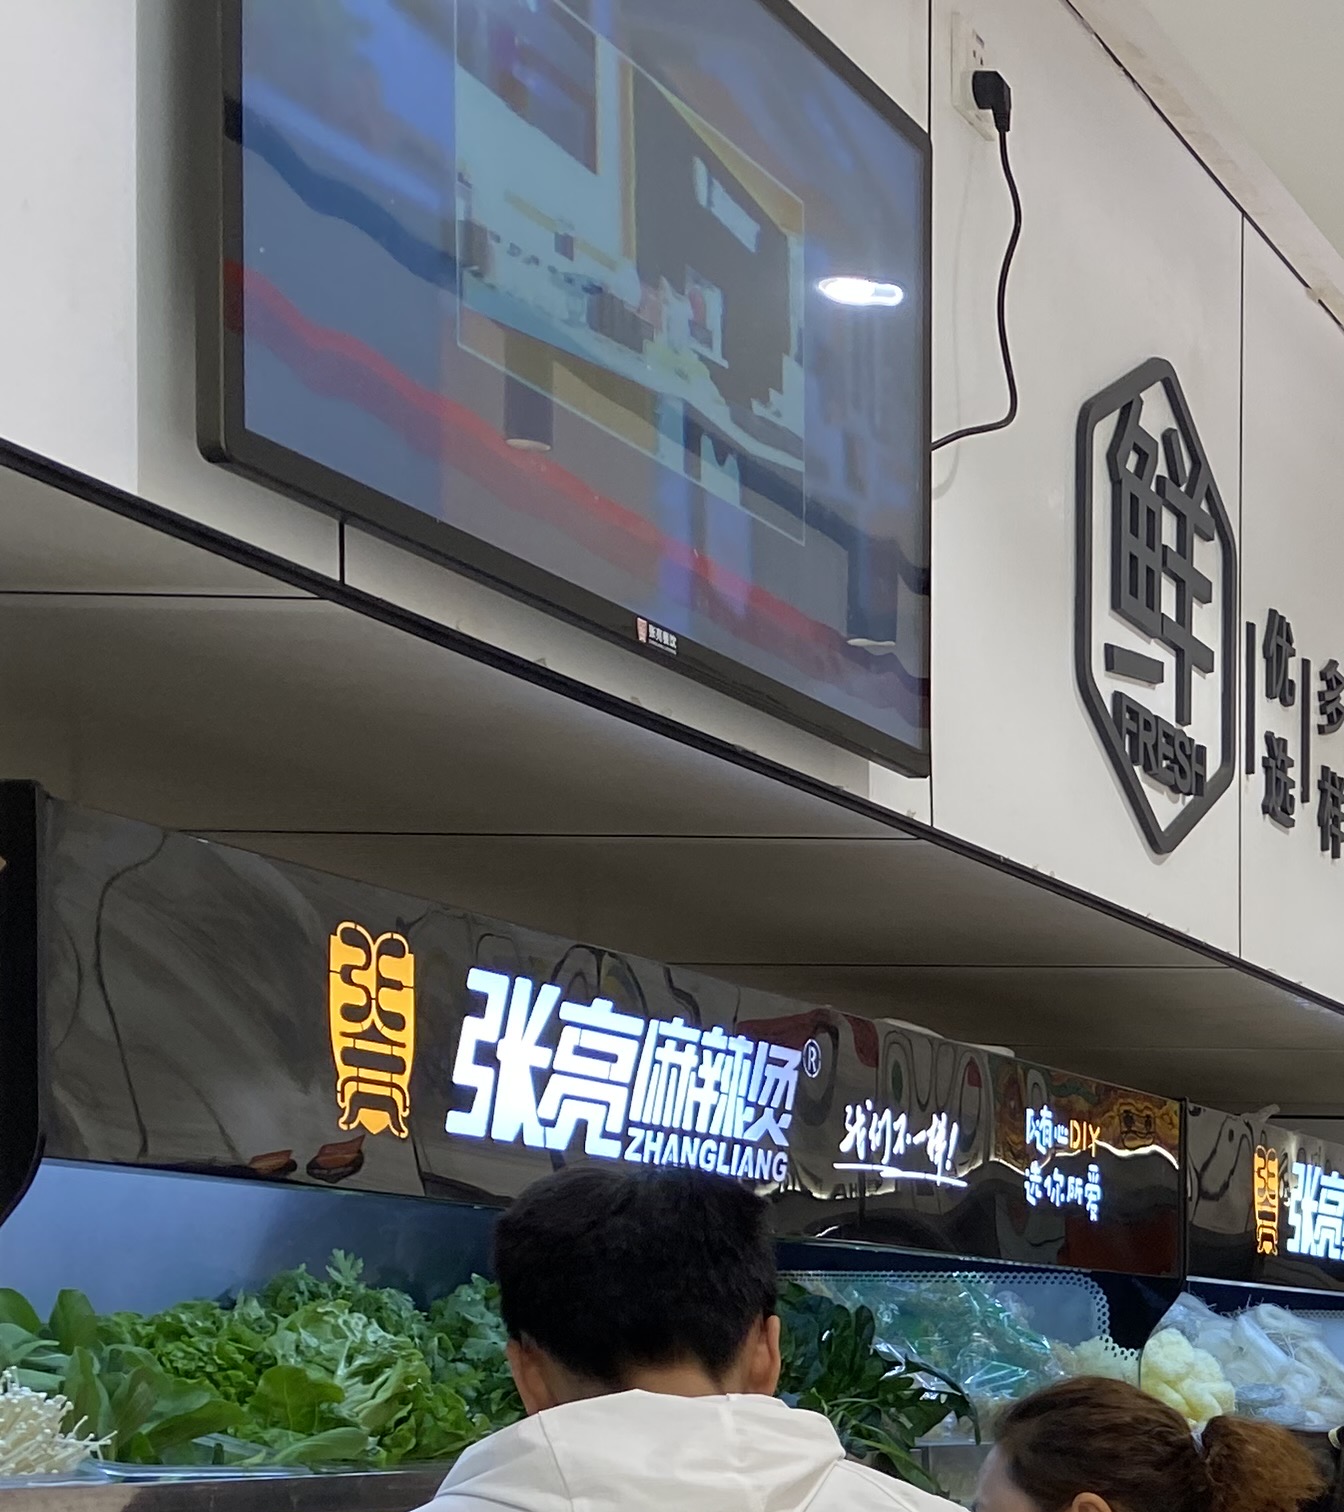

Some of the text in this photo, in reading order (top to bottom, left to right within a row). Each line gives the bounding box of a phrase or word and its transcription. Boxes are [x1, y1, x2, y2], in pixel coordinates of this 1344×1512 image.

[1105, 393, 1216, 727] 鲜
[1112, 690, 1207, 797] FRESH
[1262, 608, 1296, 828] 优选
[623, 1127, 788, 1182] ZHANGLIANG
[1024, 1159, 1102, 1222] 选你所爱
